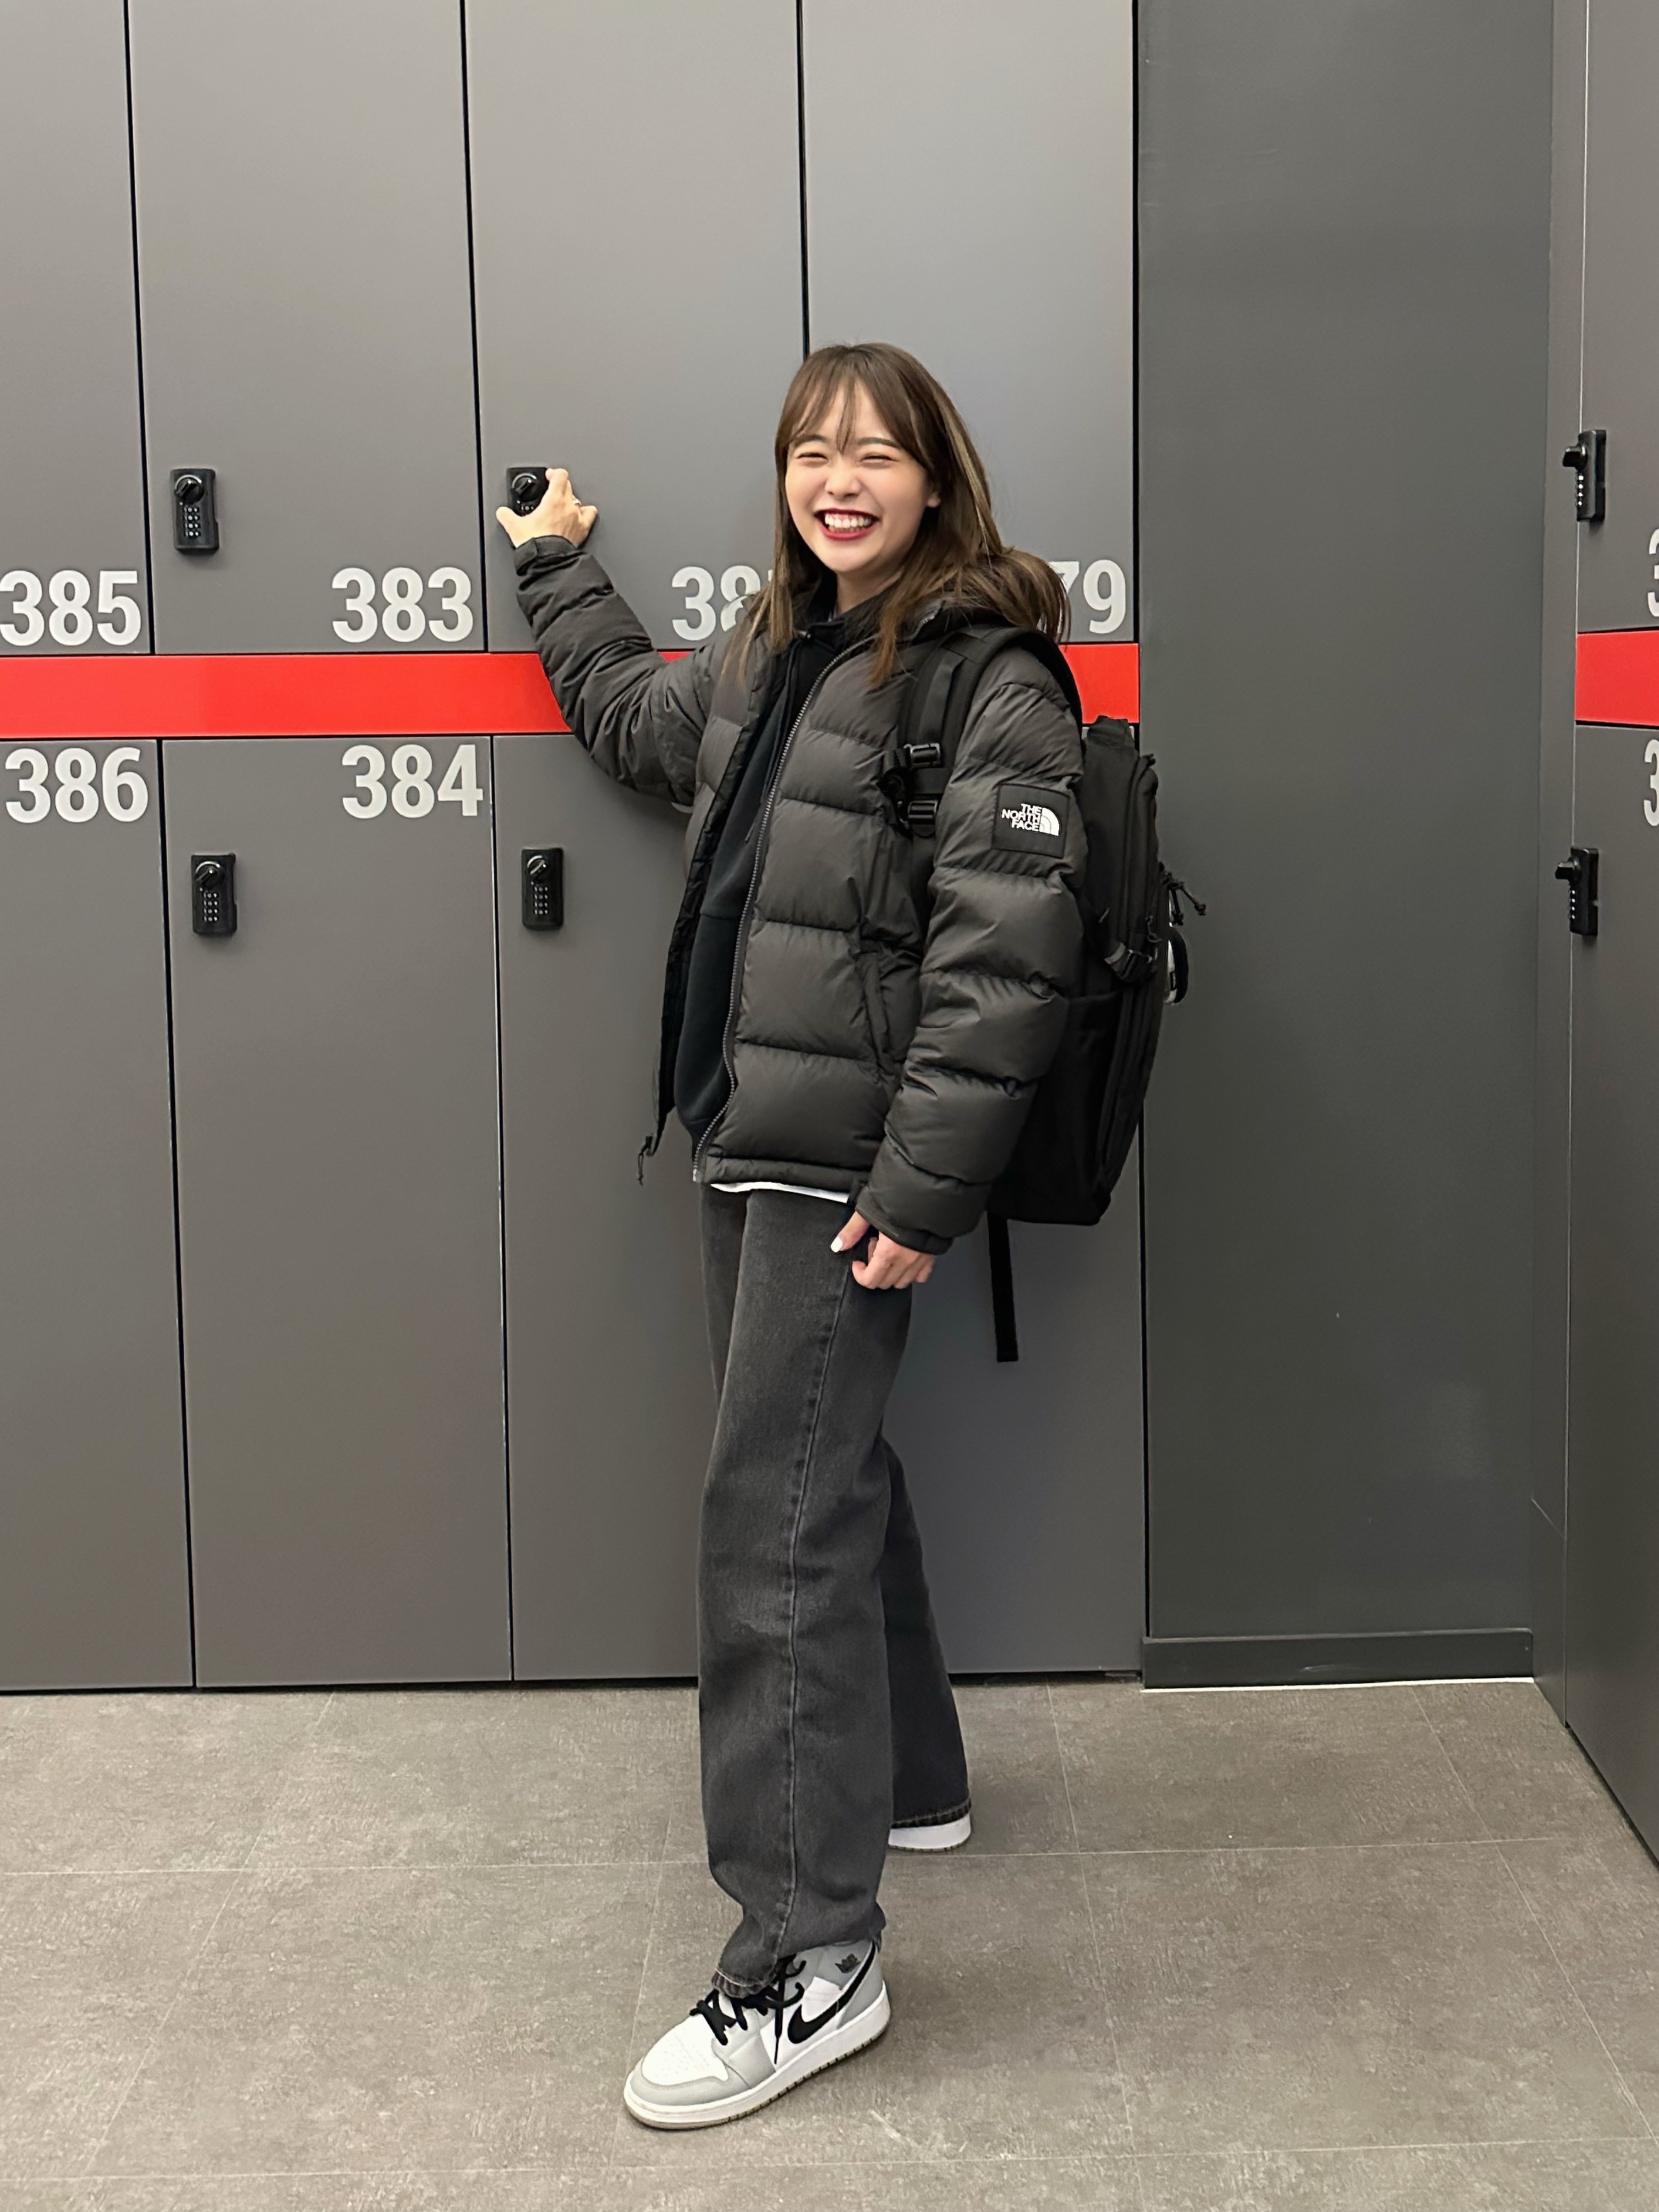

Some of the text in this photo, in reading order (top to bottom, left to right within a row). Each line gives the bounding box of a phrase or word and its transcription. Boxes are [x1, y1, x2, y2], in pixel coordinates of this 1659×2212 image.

[0, 569, 141, 646] 385
[332, 566, 473, 643] 383
[672, 565, 773, 641] 38
[1037, 559, 1126, 634] 79
[5, 747, 148, 823] 386
[341, 744, 483, 819] 384
[1001, 809, 1041, 824] NORTH
[1021, 803, 1042, 815] THE
[1011, 818, 1040, 832] FACE
